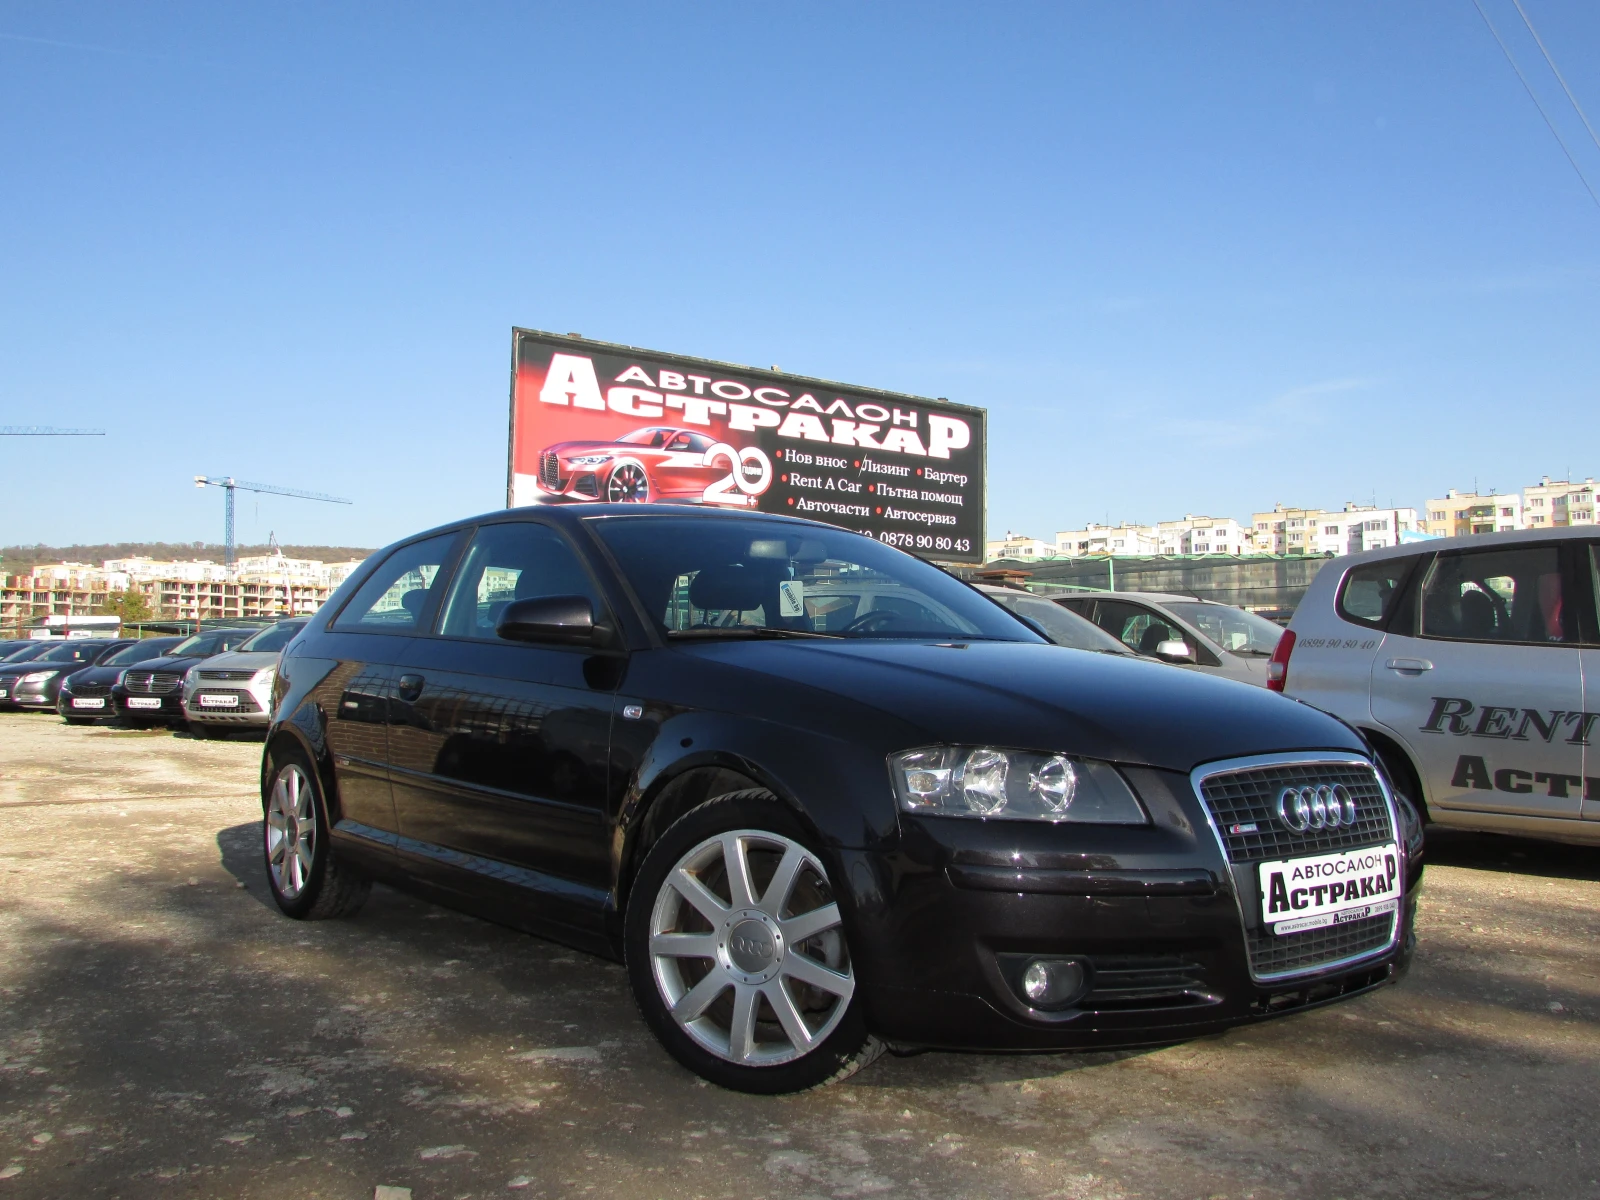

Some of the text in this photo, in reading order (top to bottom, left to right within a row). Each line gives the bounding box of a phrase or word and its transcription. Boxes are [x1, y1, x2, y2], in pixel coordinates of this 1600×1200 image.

[615, 366, 917, 428] АВТОСАЛОН
[784, 449, 848, 469] Нов внос
[861, 459, 910, 477] Лизинг
[790, 473, 862, 493] Rent A Car
[924, 467, 967, 487] Бартер
[876, 484, 963, 506] Пътна помощ
[796, 498, 870, 517] Авточасти
[884, 507, 956, 527] Автосервиз
[880, 531, 914, 547] 0878
[916, 535, 933, 548] 90
[935, 537, 951, 550] 80
[954, 539, 970, 552] 43
[1298, 638, 1375, 650] 0899 90 80 40
[1292, 854, 1382, 881] АВТОСАЛОН
